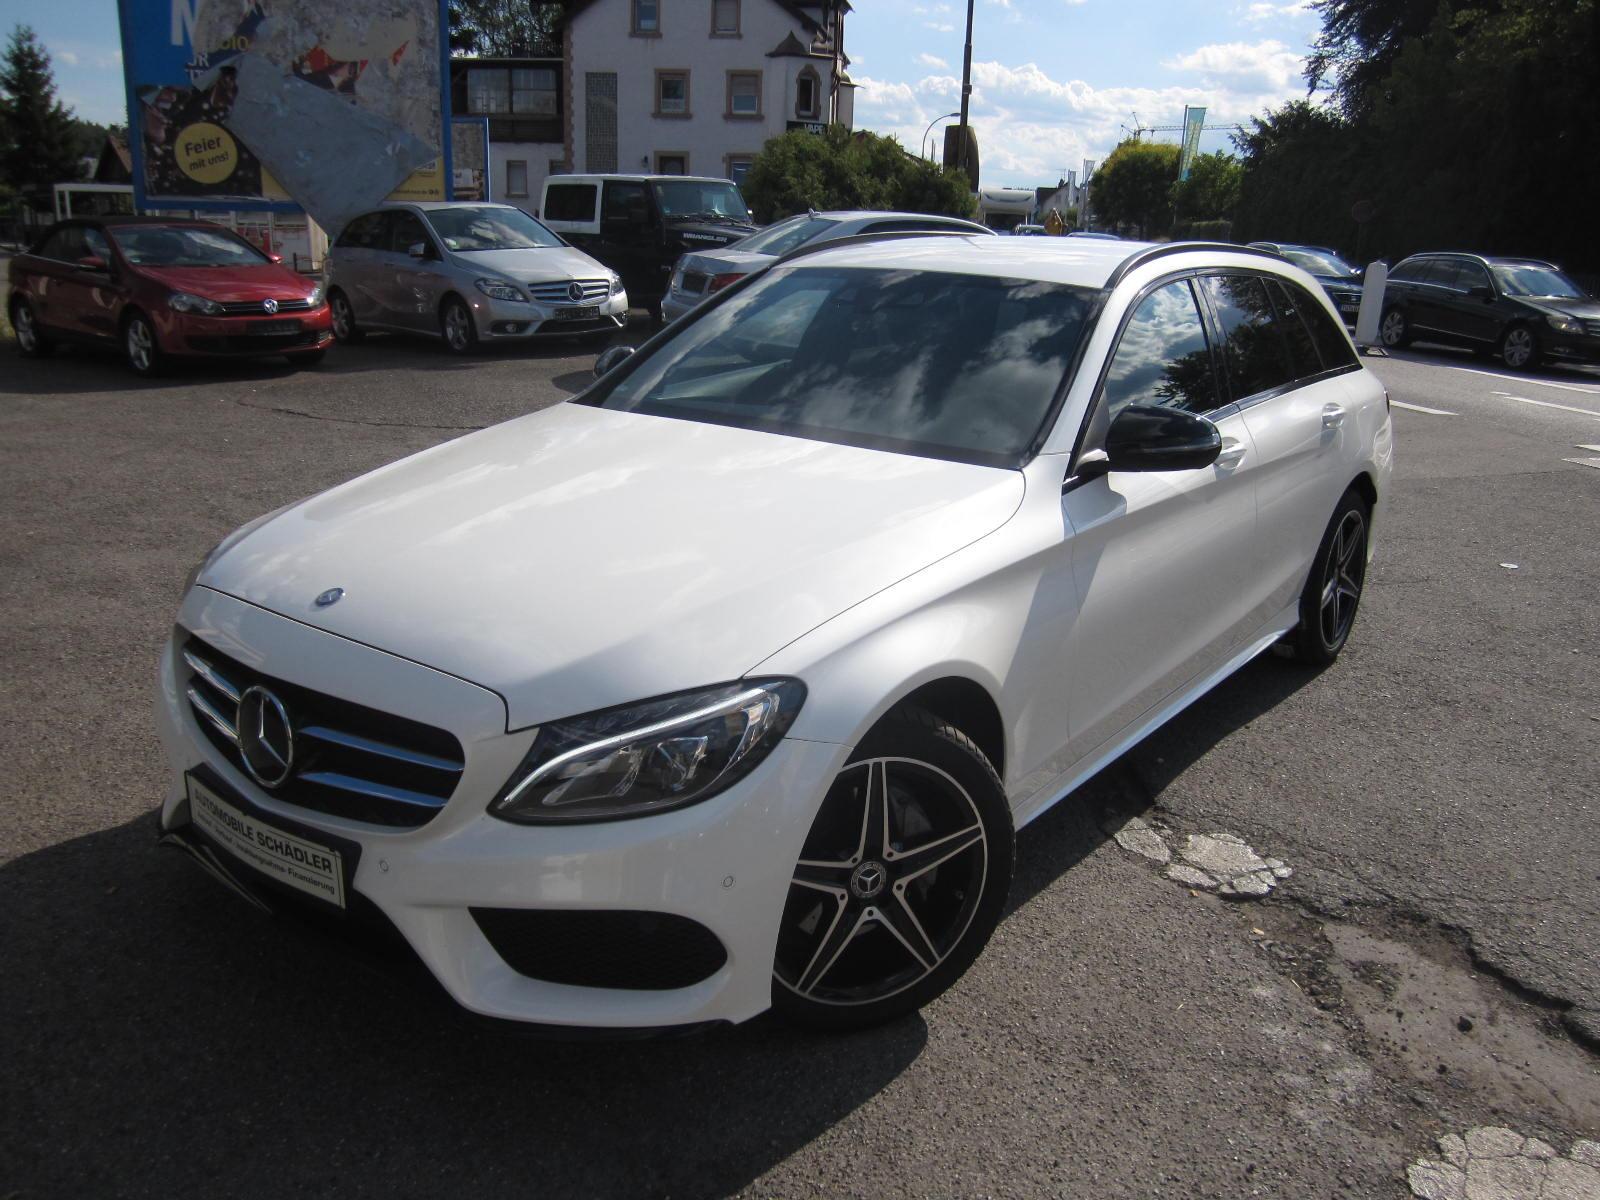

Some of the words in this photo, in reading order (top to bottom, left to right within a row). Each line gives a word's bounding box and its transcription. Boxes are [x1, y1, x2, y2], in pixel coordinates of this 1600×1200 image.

[184, 137, 221, 156] Feier
[189, 159, 206, 171] mit
[207, 152, 229, 165] uns!
[194, 788, 254, 841] AUTOMOBILE
[257, 831, 333, 873] SCHÄDLER
